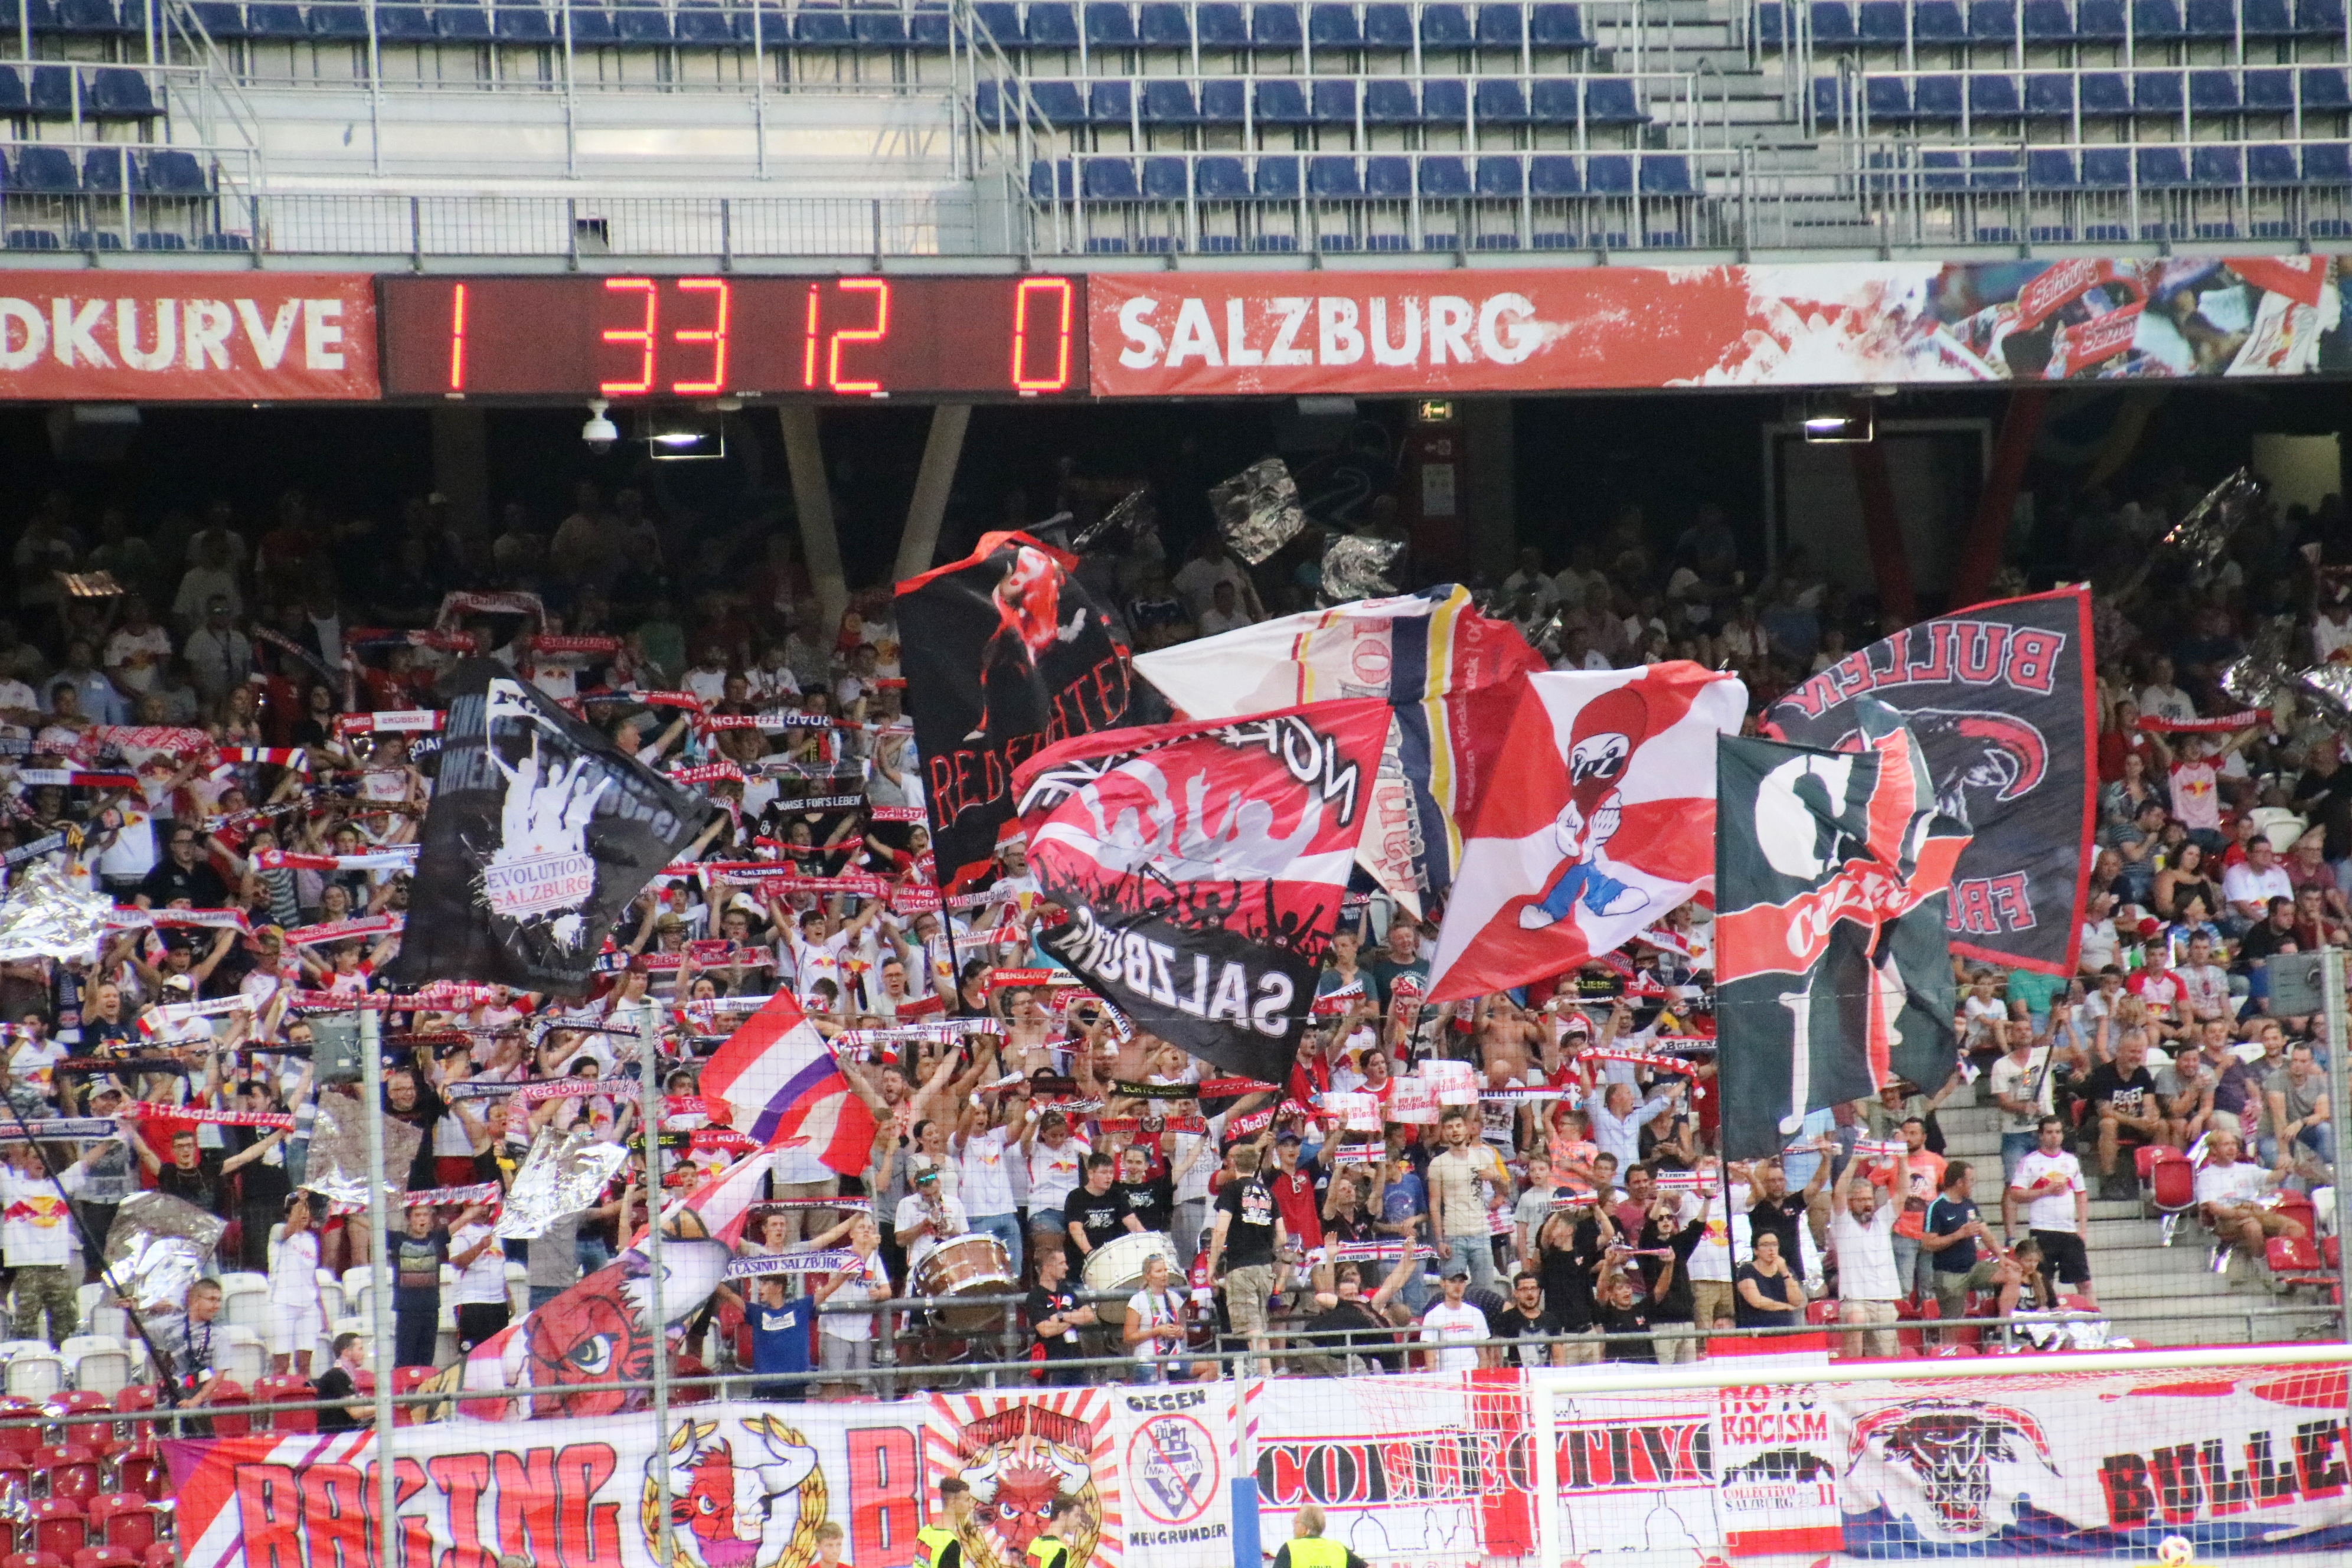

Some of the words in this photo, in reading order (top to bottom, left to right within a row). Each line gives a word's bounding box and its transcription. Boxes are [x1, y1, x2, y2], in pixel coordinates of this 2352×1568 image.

[451, 282, 466, 391] 1
[601, 277, 732, 394] 33
[805, 277, 890, 394] 12
[1013, 277, 1072, 393] 0
[1118, 293, 1542, 370] SALZBURG
[833, 795, 862, 806] LEBEN
[486, 855, 590, 888] EVOLUTION
[491, 874, 590, 906] SALZBURG
[528, 1087, 556, 1099] Red
[735, 1260, 778, 1275] CASINO
[781, 1256, 842, 1270] SALZBURG
[1126, 1389, 1206, 1412] GEGEN
[1721, 1412, 1828, 1446] RACISM
[2097, 1417, 2352, 1533] BULLE
[1722, 1484, 1796, 1501] COLLECTIVO
